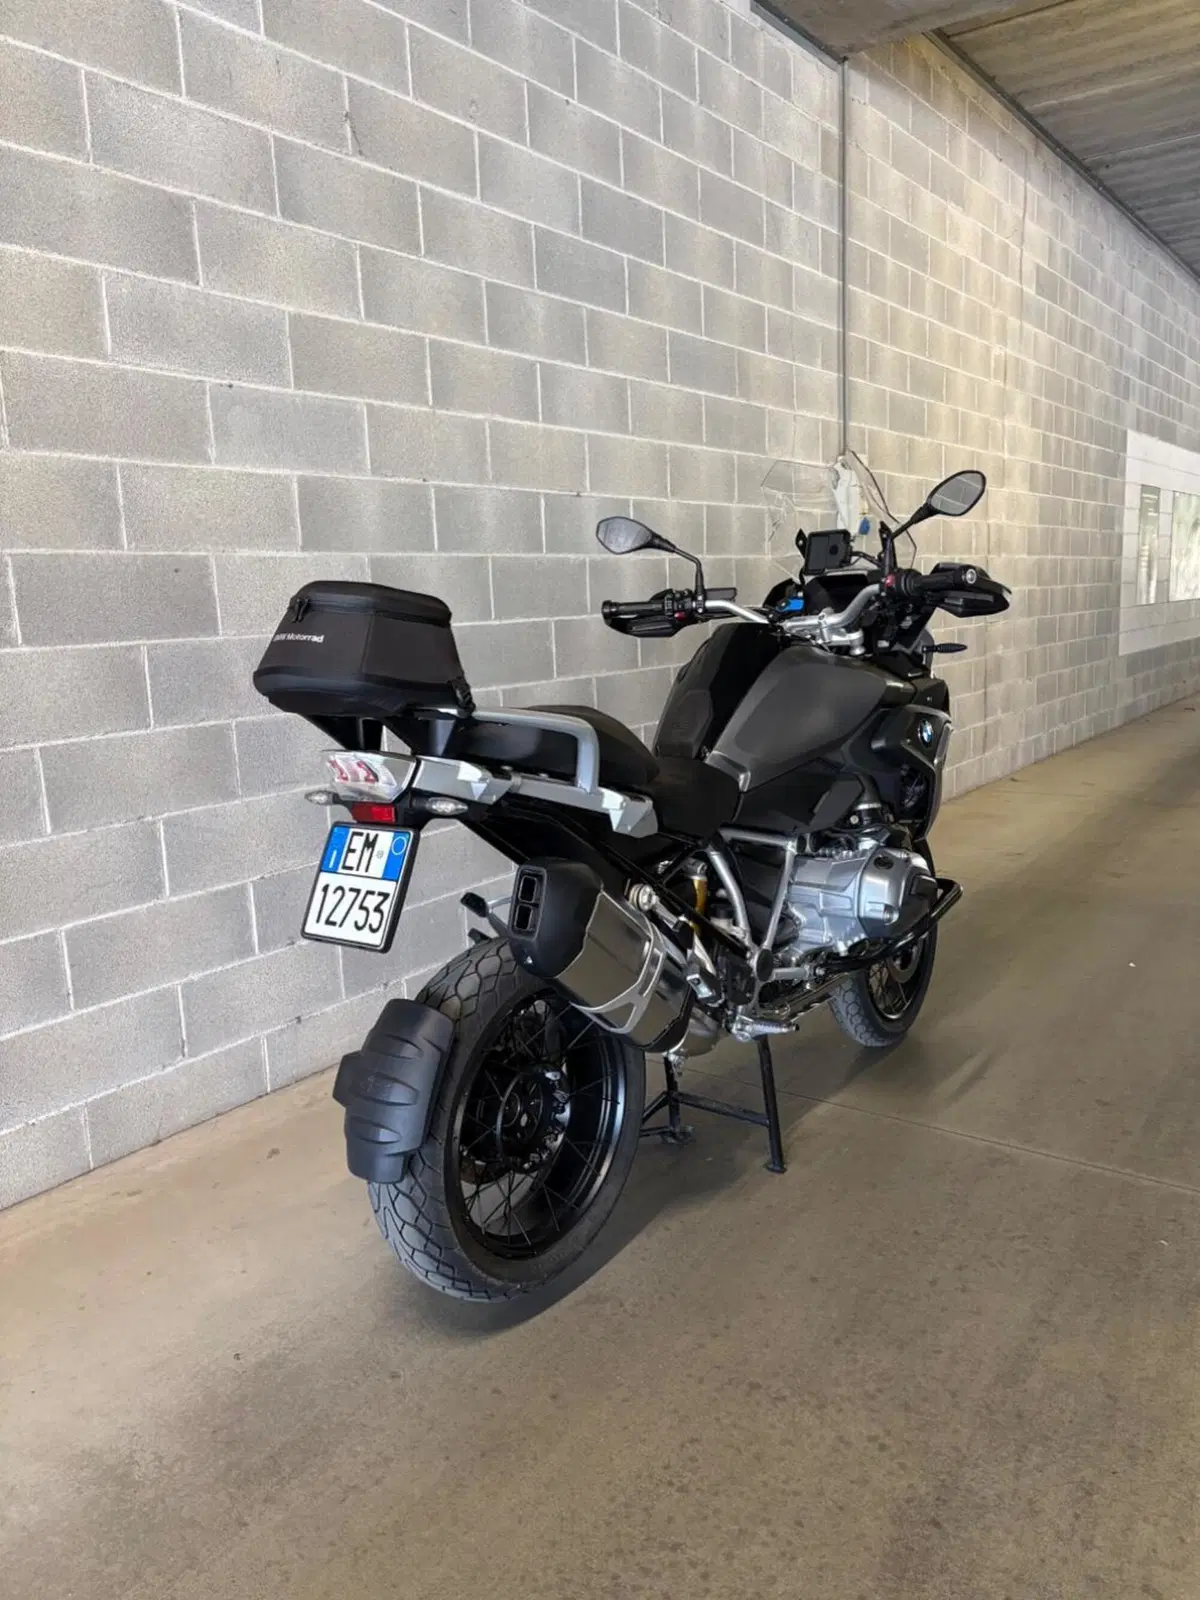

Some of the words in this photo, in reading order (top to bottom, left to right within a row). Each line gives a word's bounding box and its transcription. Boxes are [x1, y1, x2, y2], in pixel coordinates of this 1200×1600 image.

[287, 632, 325, 643] Motorrad
[341, 831, 379, 873] EM
[316, 883, 391, 934] 12753
